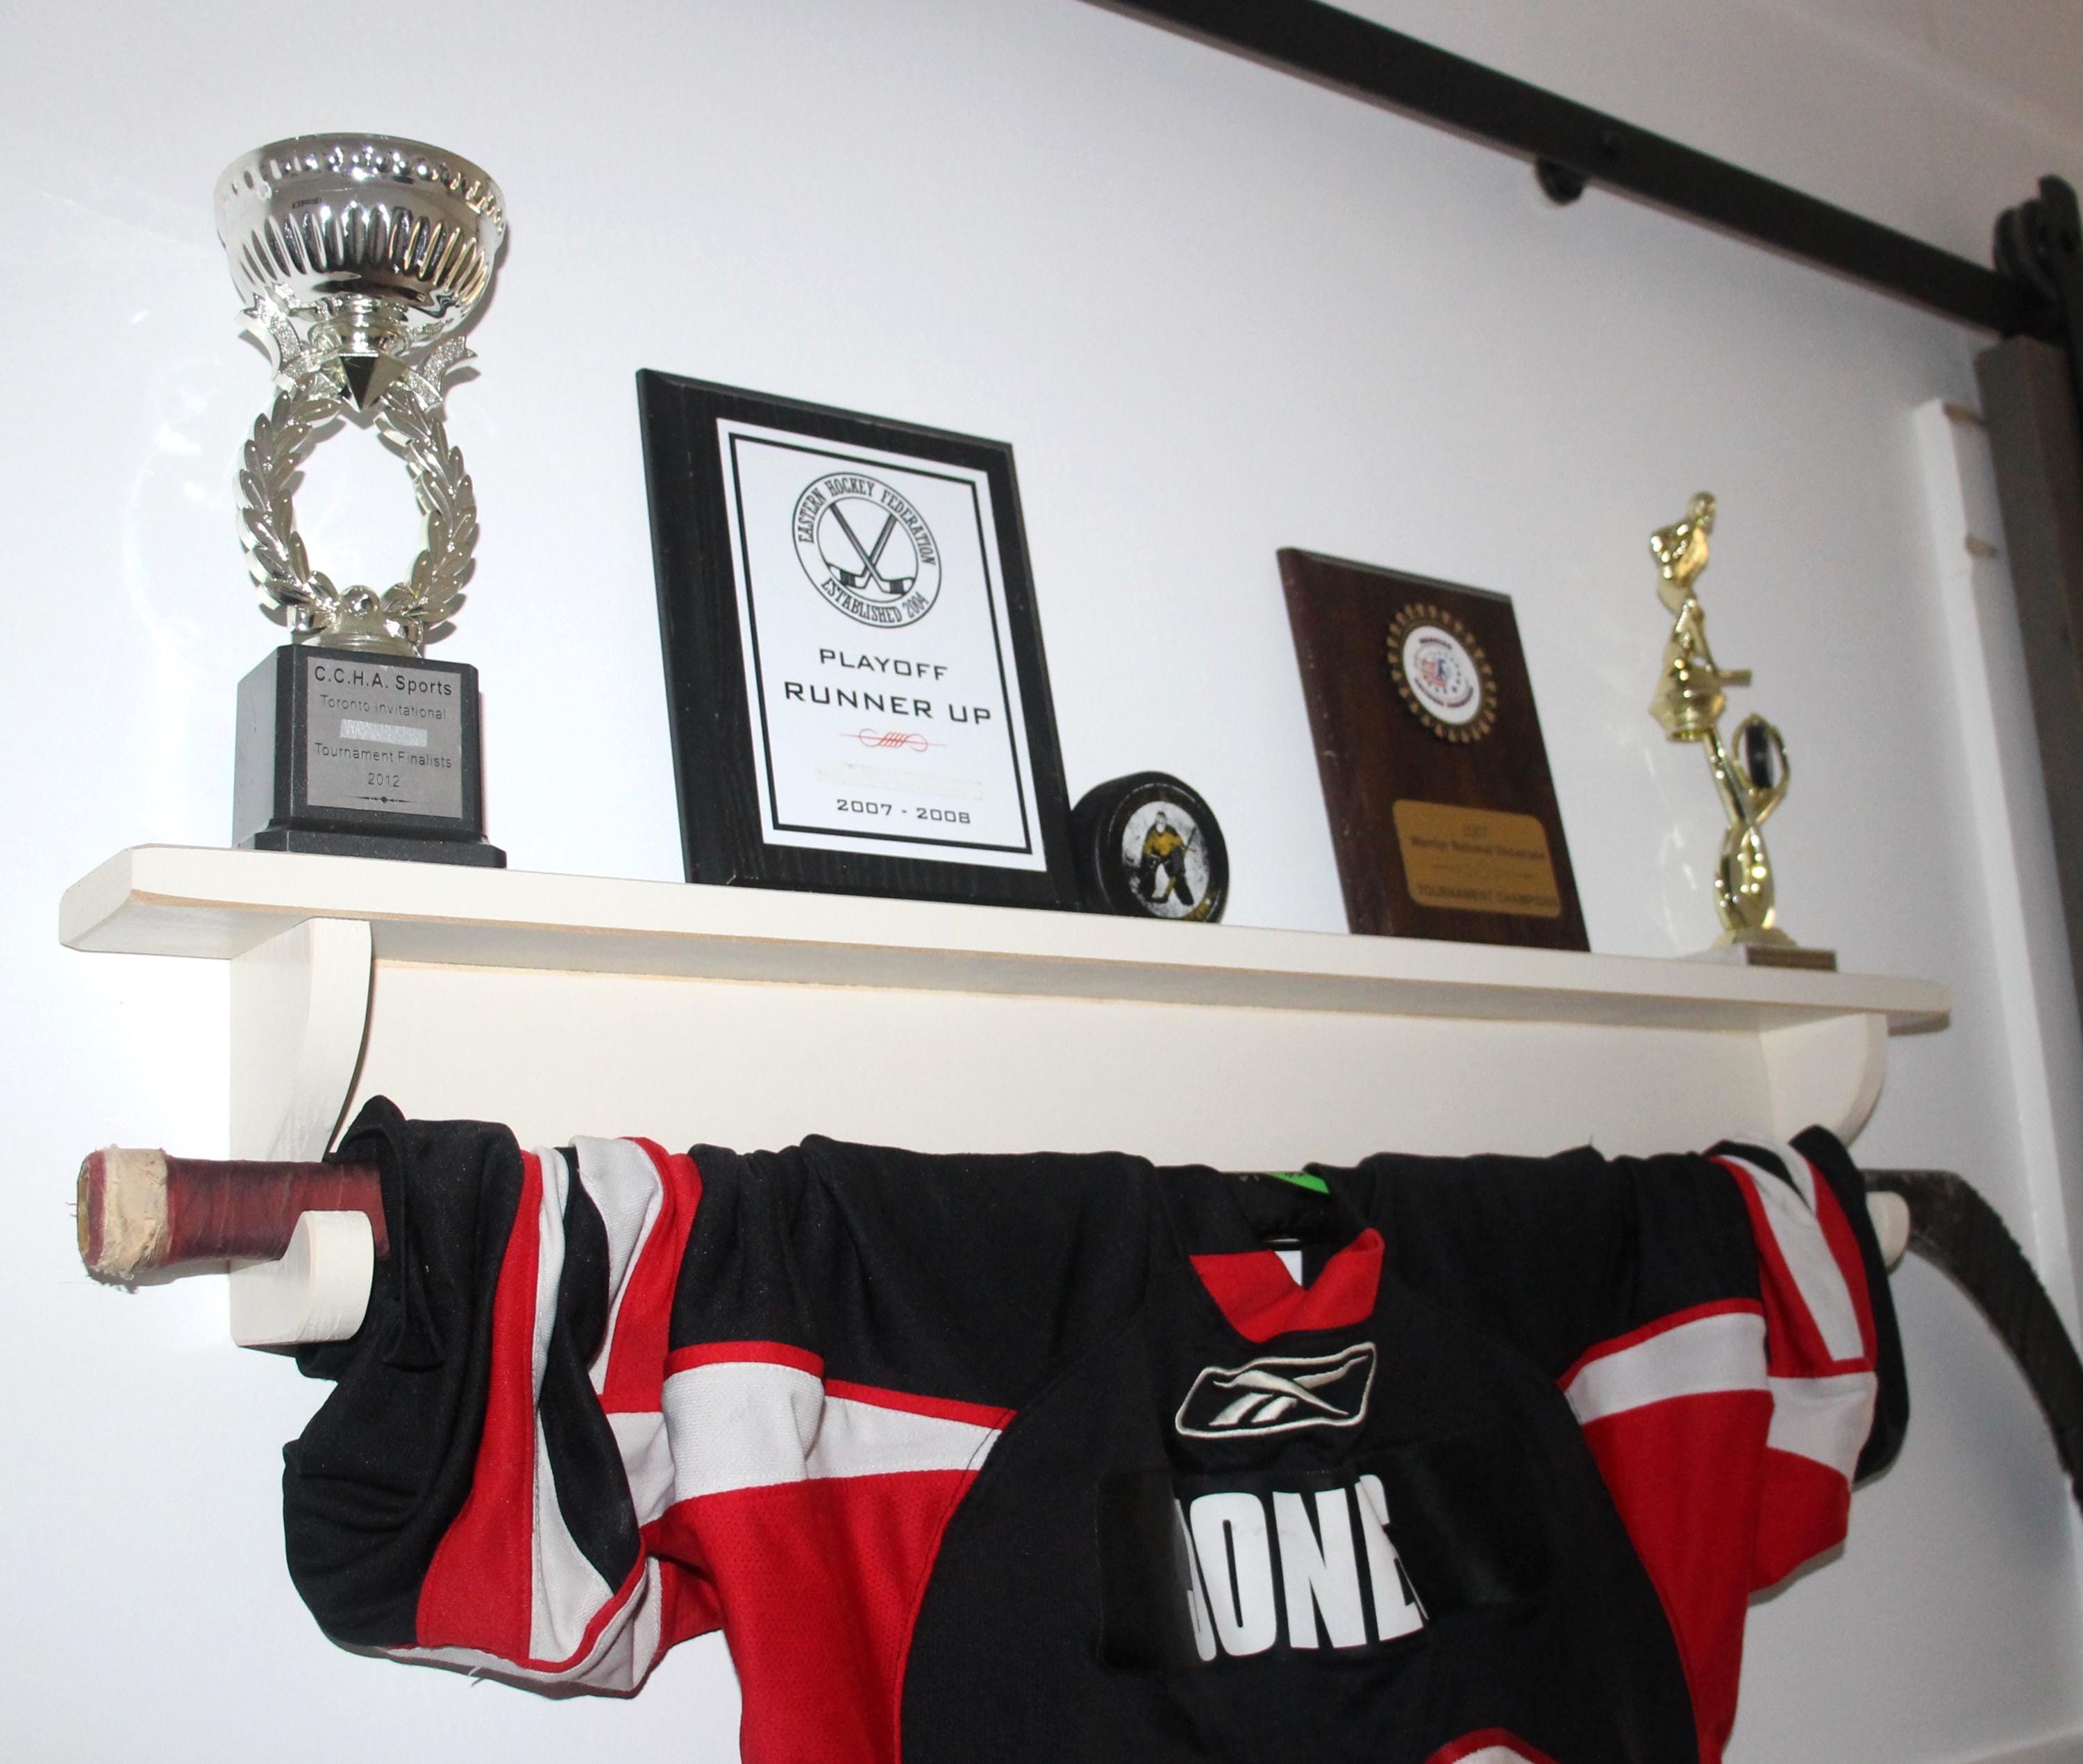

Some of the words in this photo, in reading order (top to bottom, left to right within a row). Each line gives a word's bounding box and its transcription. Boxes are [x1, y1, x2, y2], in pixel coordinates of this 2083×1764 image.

[797, 487, 827, 544] EASTERN
[824, 477, 875, 497] HOCKEY
[880, 488, 937, 566] FEDERATION
[821, 577, 903, 623] ESTABLISHED
[819, 648, 948, 680] PLAYOFF
[315, 666, 389, 689] C.C.H.A.
[395, 675, 453, 696] Sports
[320, 694, 371, 713] Toronto
[374, 701, 446, 719] Invitational
[784, 681, 934, 718] RUNNER
[948, 703, 992, 724] UP
[315, 742, 394, 763] Tournament
[398, 750, 452, 768] Finalists
[367, 773, 401, 788] 2012
[837, 799, 893, 816] 2007
[916, 807, 971, 824] 2008
